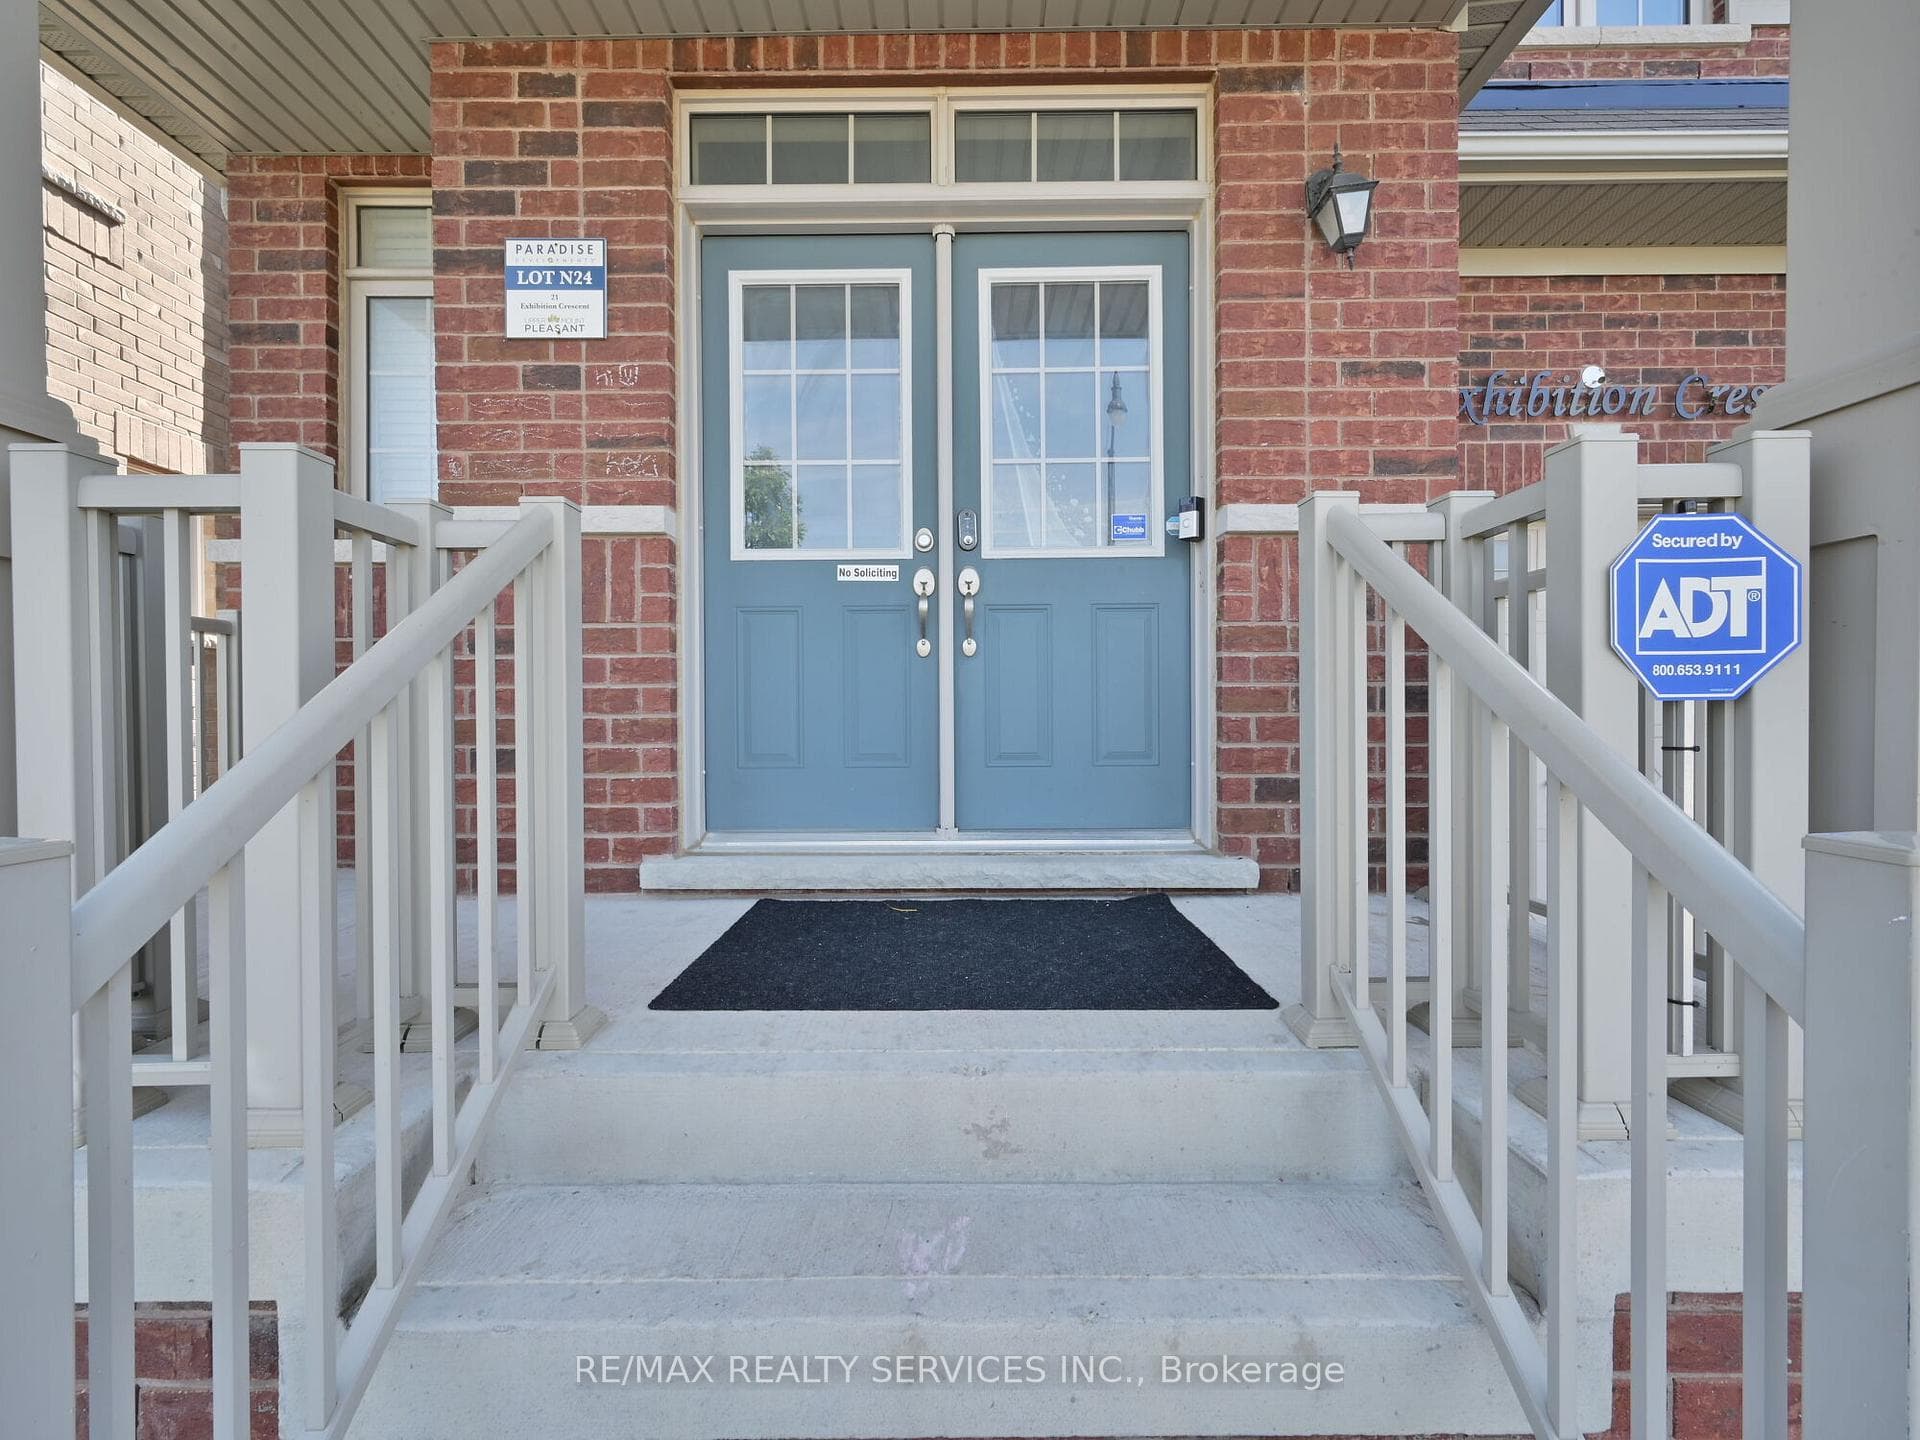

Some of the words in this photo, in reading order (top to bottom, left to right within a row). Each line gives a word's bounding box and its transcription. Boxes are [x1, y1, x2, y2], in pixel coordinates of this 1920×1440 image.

[515, 244, 594, 255] PARADISE
[516, 270, 556, 285] LOT
[559, 270, 593, 285] N24
[524, 324, 586, 333] PLEASANT
[1459, 369, 1656, 426] xhibition
[1652, 533, 1717, 548] Secured
[1720, 533, 1743, 549] by
[839, 568, 851, 577] No
[854, 568, 897, 579] Soliciting
[1652, 664, 1741, 676] 800.653.9111
